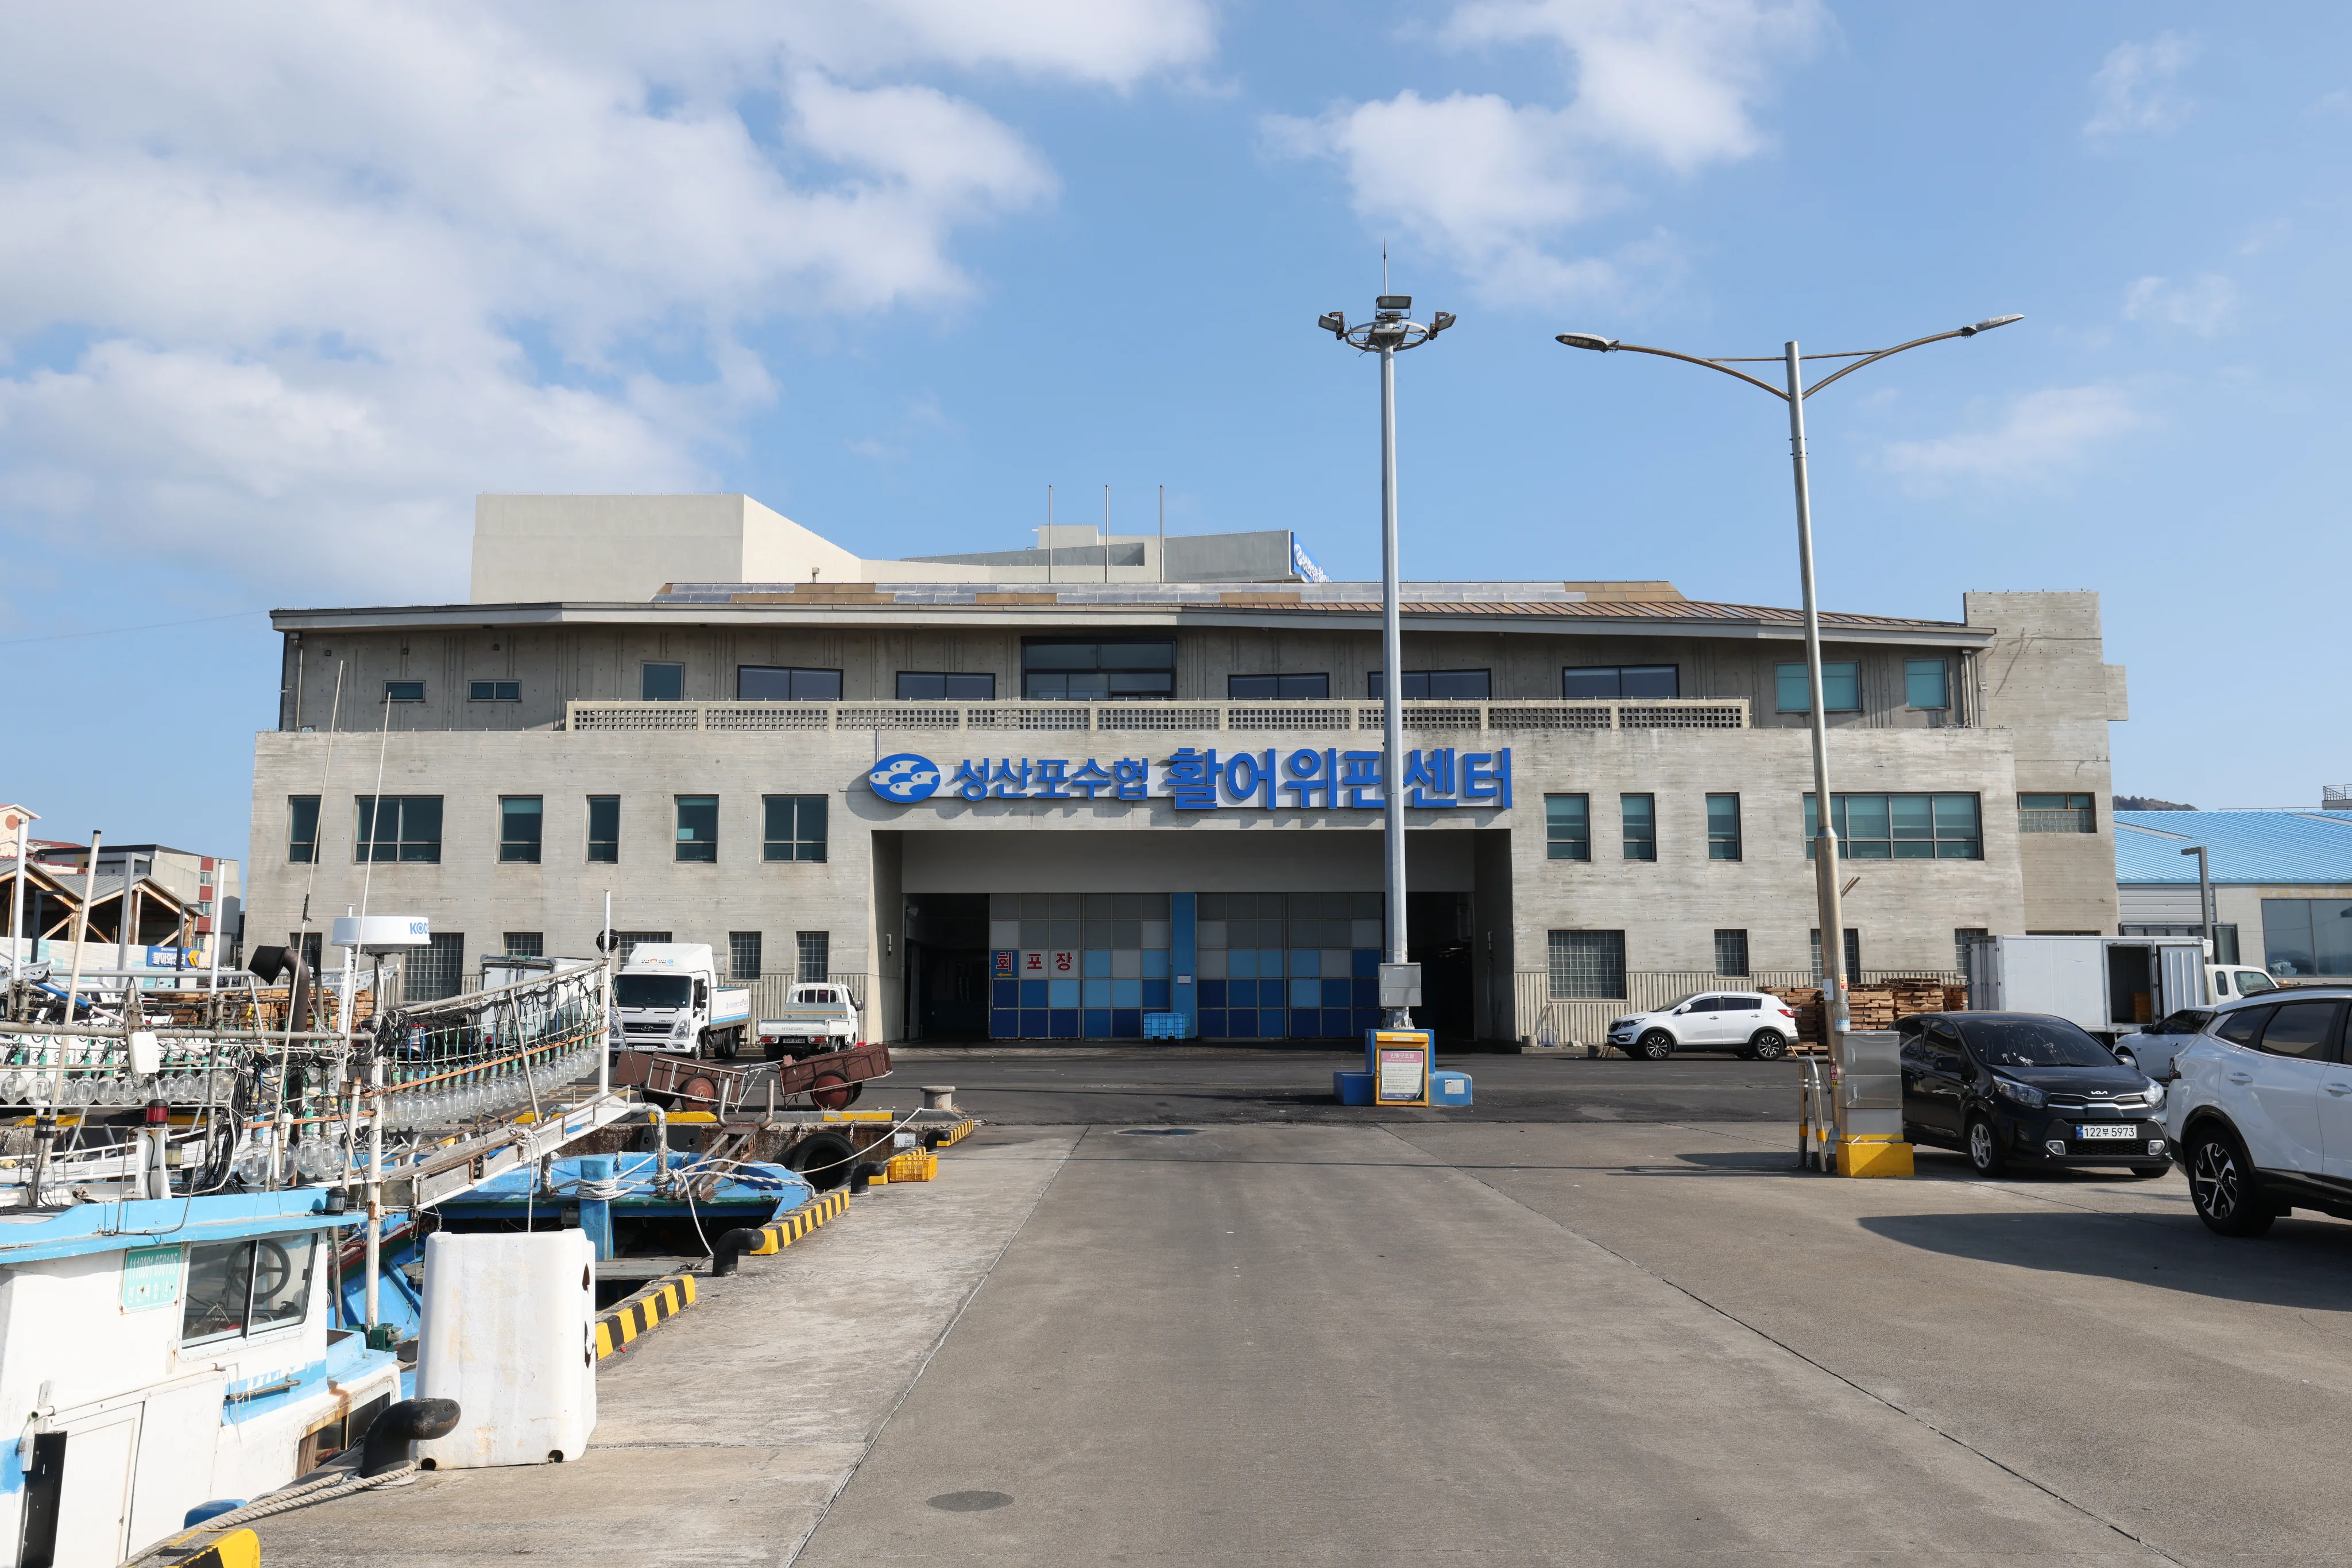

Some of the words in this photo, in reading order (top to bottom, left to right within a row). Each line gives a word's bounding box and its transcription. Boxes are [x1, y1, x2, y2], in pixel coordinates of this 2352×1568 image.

[953, 757, 1148, 802] 성산포수협
[1166, 748, 1512, 810] 활어위판센터
[2084, 1128, 2109, 1137] 122부
[2111, 1128, 2134, 1137] 5973
